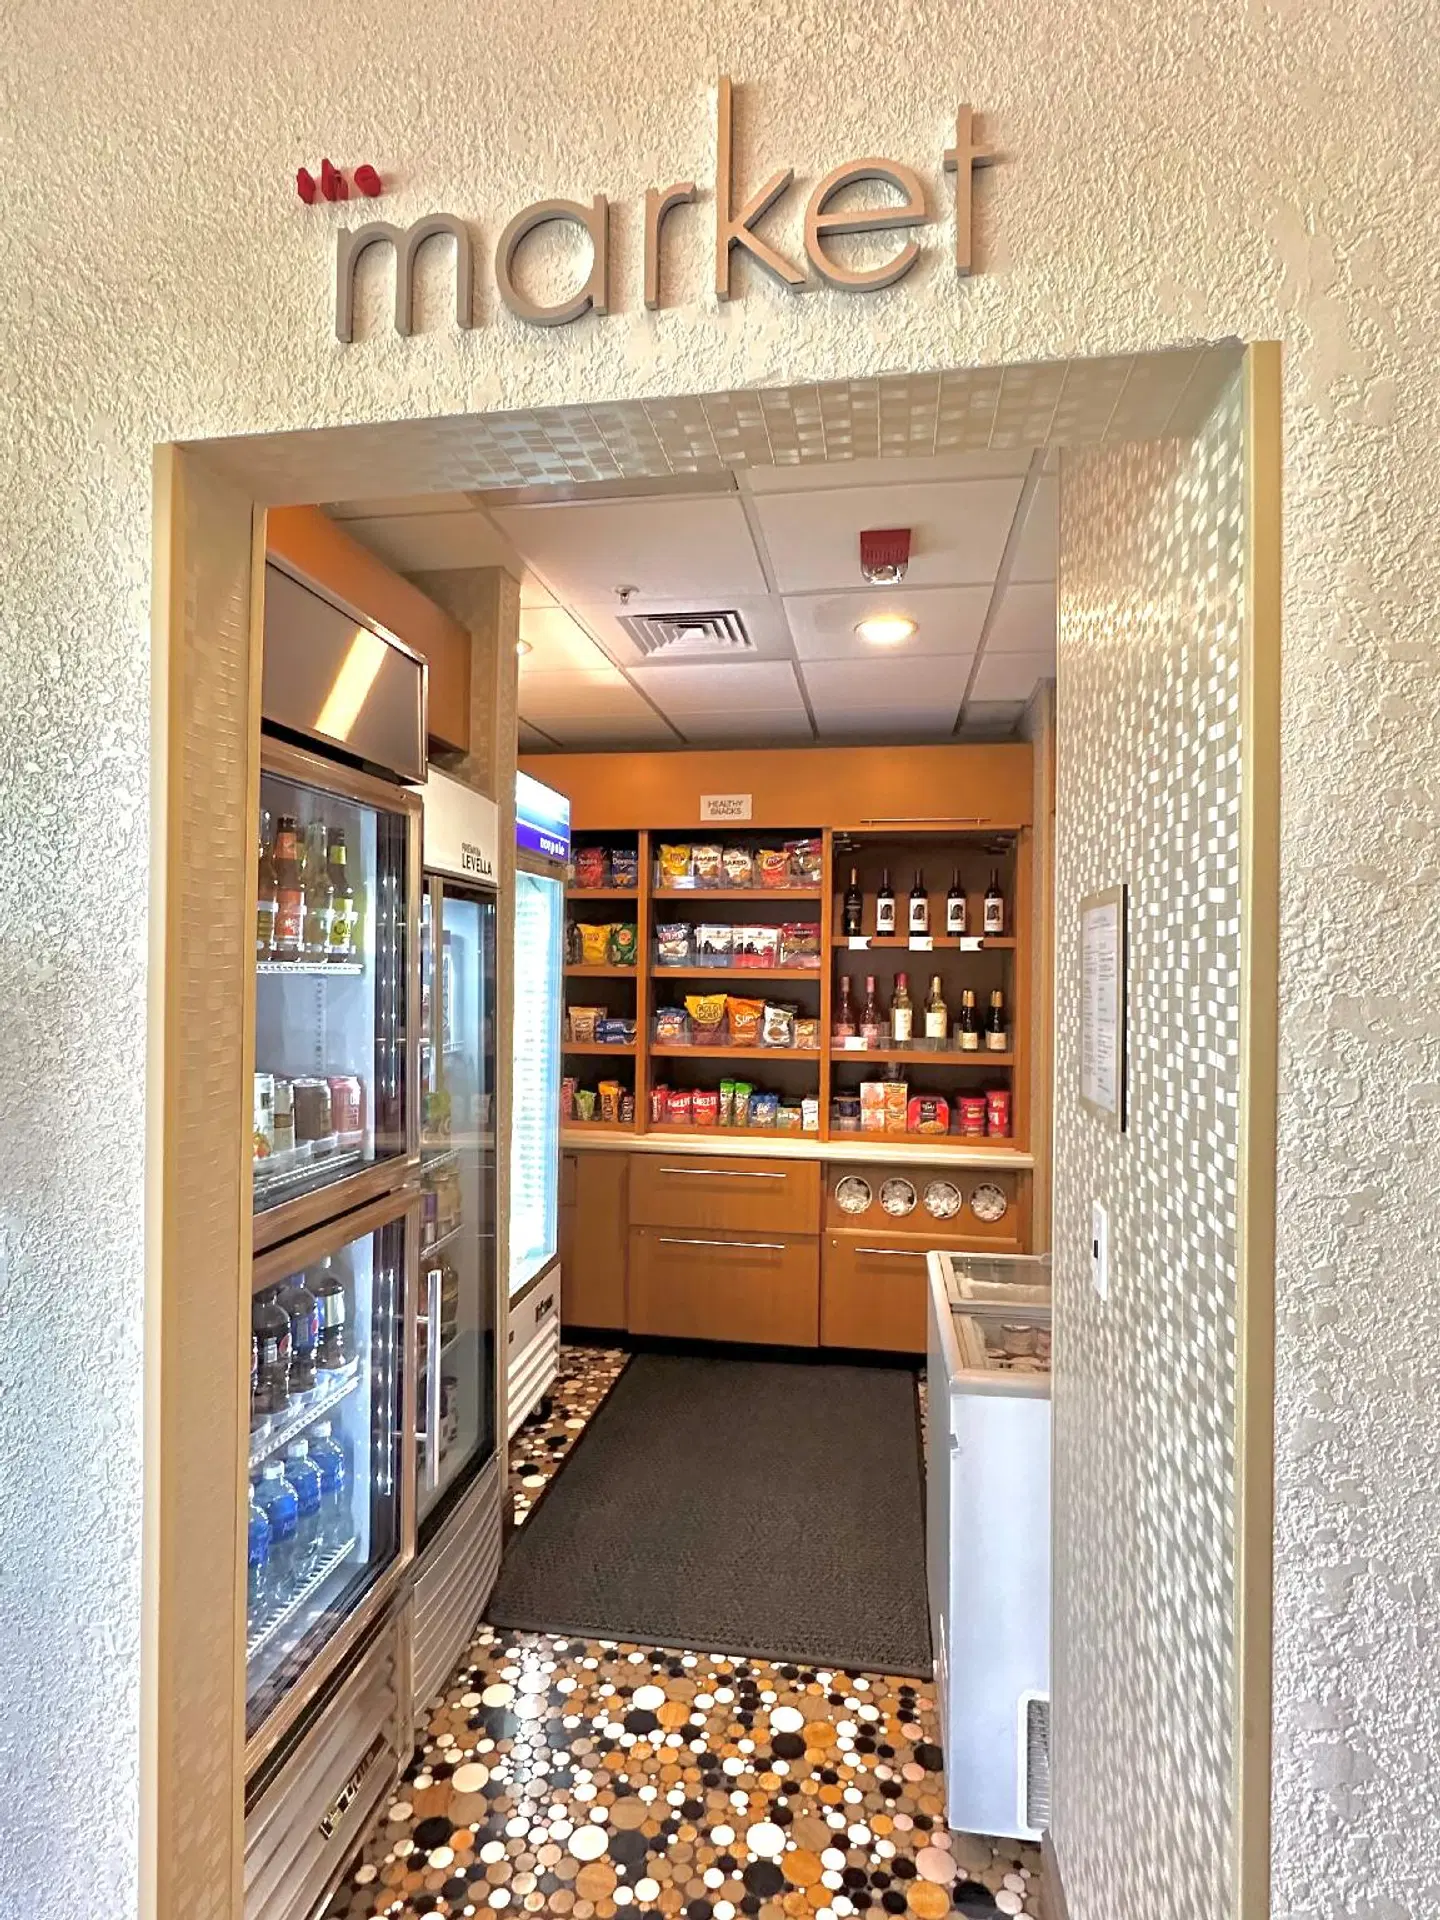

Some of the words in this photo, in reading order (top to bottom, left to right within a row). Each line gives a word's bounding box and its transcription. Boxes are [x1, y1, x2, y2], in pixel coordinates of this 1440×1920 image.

[296, 157, 383, 205] the
[336, 74, 998, 343] market
[708, 799, 743, 808] HEALTHY
[462, 854, 493, 876] LEVELLA
